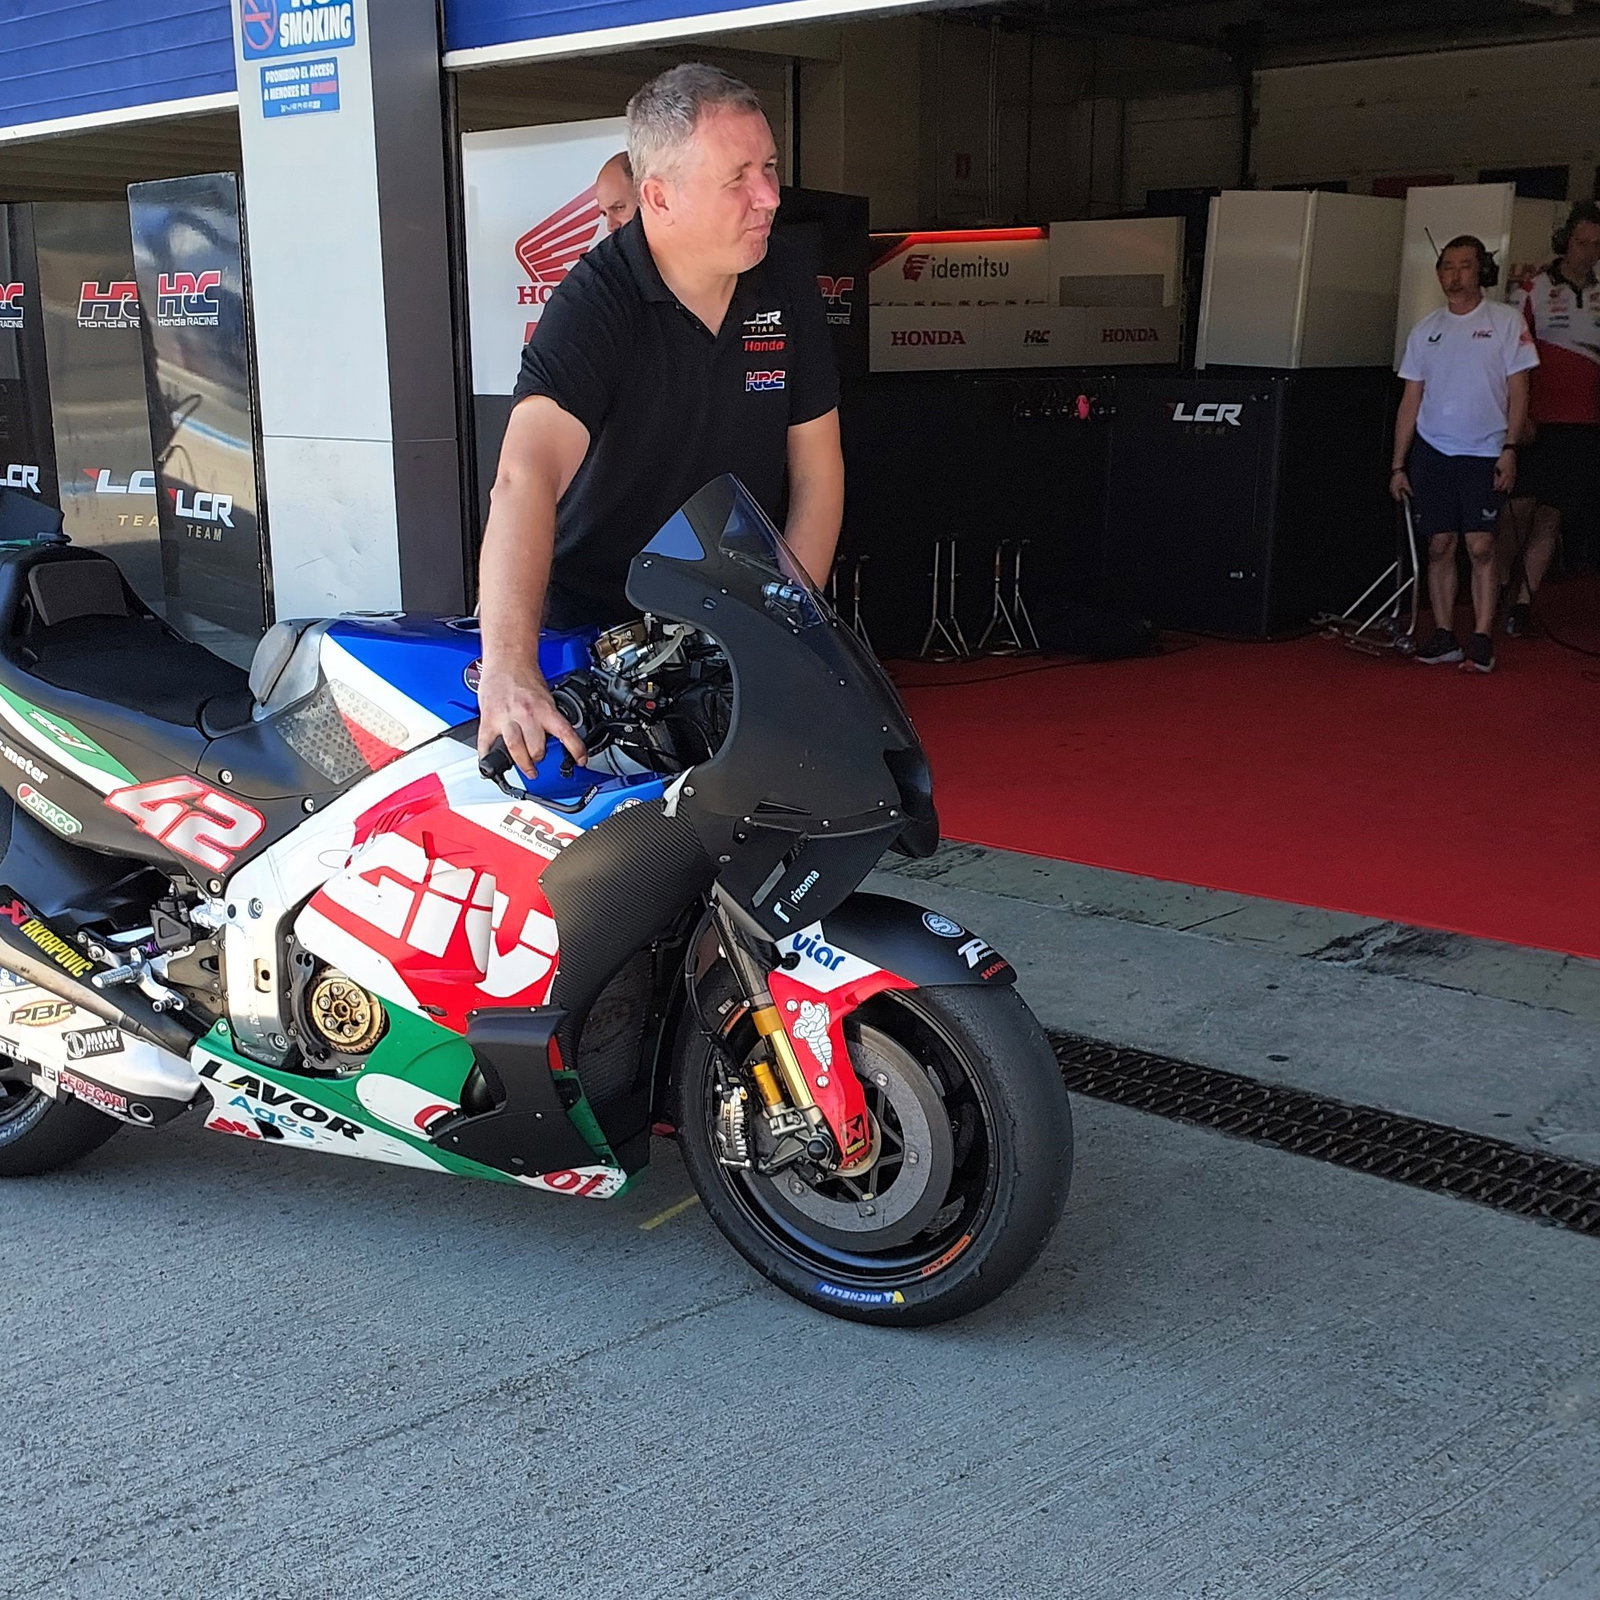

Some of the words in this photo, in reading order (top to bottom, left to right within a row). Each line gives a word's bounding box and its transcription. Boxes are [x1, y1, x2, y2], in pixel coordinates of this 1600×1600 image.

[280, 3, 352, 48] SMOKING
[265, 67, 300, 84] PROHIBIDO
[301, 66, 309, 79] EL
[310, 62, 335, 77] ACCESO
[264, 88, 270, 101] A
[270, 85, 300, 100] MENORES
[301, 83, 310, 96] DE
[931, 255, 1009, 279] idemitsu
[157, 270, 222, 318] HRC
[78, 320, 127, 329] Honda
[157, 316, 186, 327] Honda
[186, 315, 220, 327] RACING
[744, 340, 785, 352] Honda
[890, 330, 966, 347] HONDA
[1023, 330, 1051, 344] HRC
[1101, 328, 1159, 343] HONDA
[745, 370, 786, 392] HRC
[1172, 402, 1243, 426] LCR
[95, 469, 156, 494] LC
[118, 514, 159, 527] TEA
[175, 489, 236, 529] LCR
[186, 524, 223, 542] TEAM
[25, 788, 79, 835] DRACO
[104, 774, 266, 873] 42
[499, 823, 534, 847] Honda
[790, 869, 821, 904] rizoma
[791, 932, 846, 972] viar
[8, 1002, 77, 1025] PBR
[86, 1029, 118, 1048] MIW
[59, 1071, 128, 1109] FEDEGARI
[198, 1059, 364, 1142] LAVOR
[820, 1283, 883, 1304] MICHELIN
